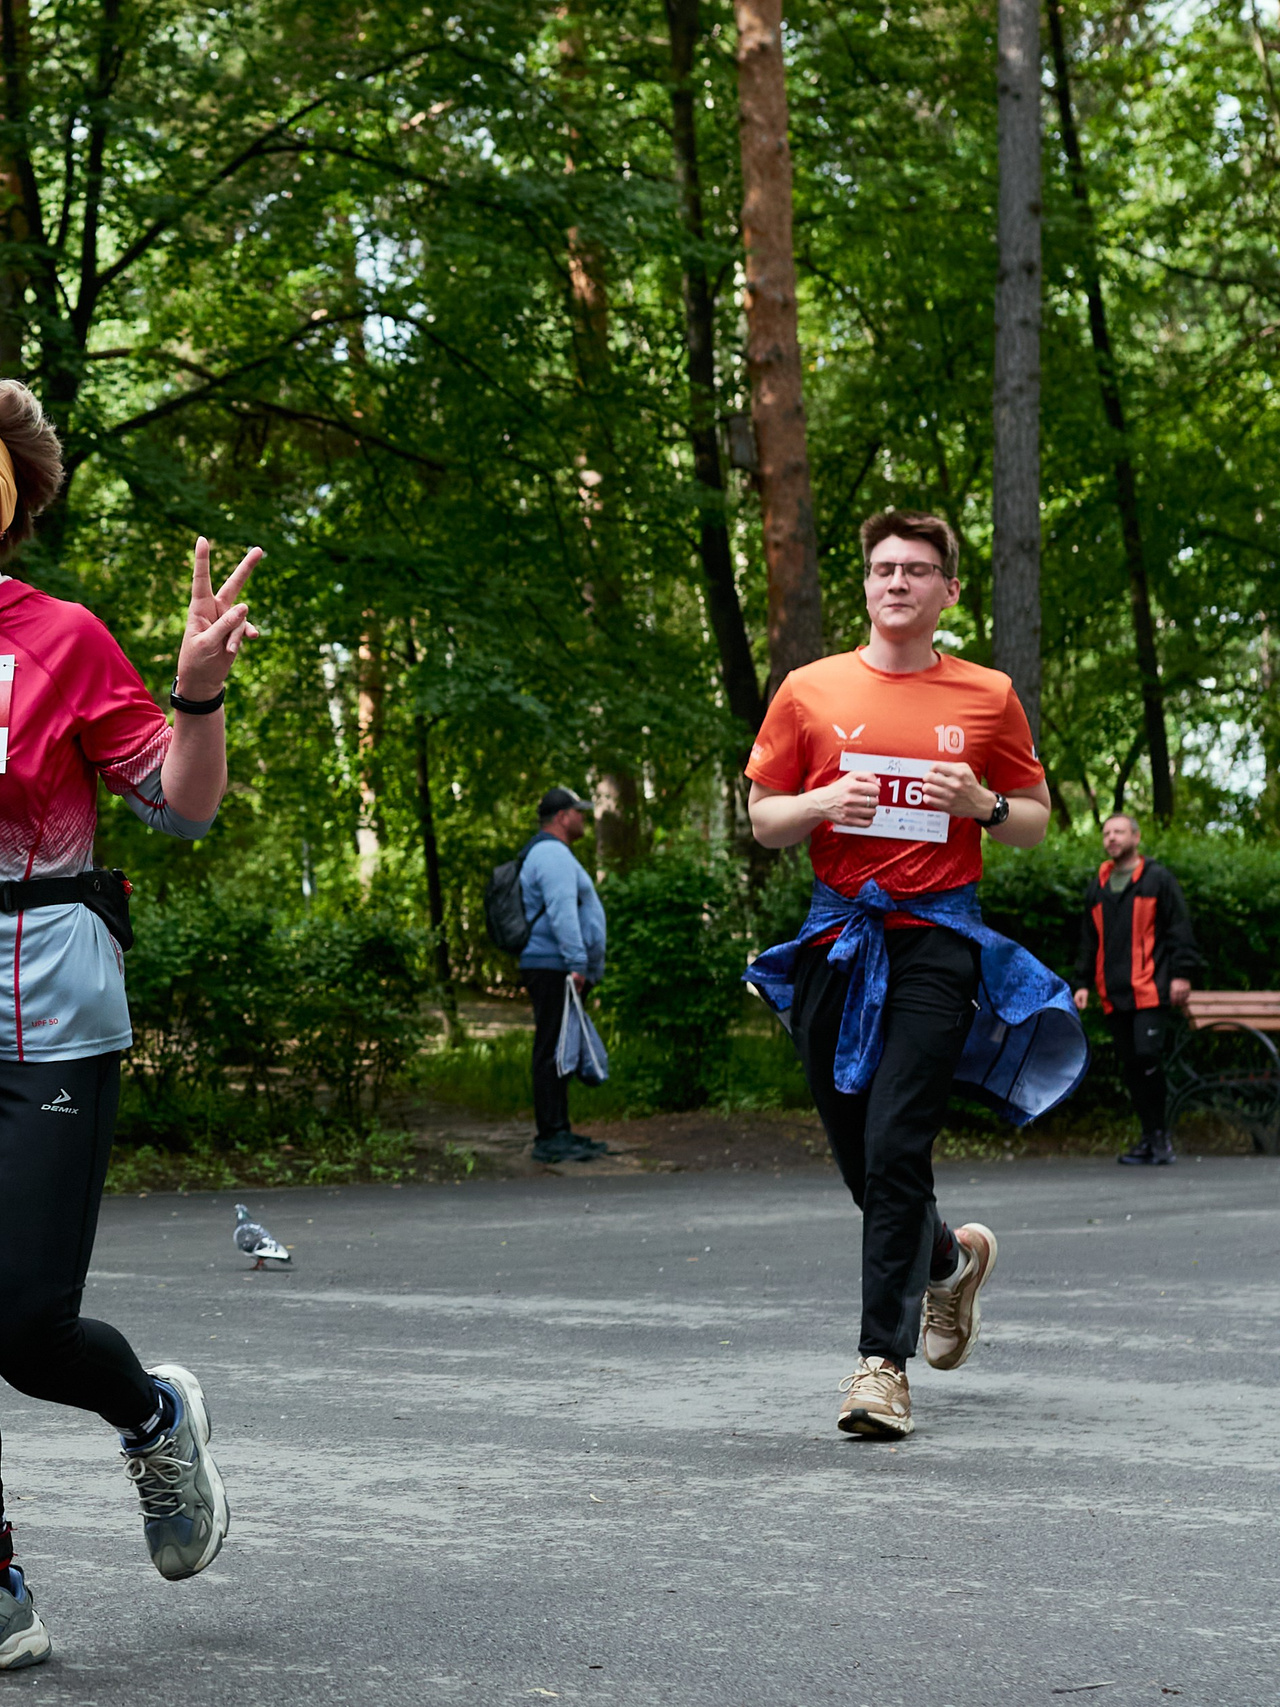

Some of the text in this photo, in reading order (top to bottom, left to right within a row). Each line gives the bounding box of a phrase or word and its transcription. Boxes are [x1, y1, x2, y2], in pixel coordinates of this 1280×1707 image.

[934, 724, 965, 754] 10
[31, 1017, 59, 1028] UPF 50
[40, 1103, 80, 1115] DEMIX
